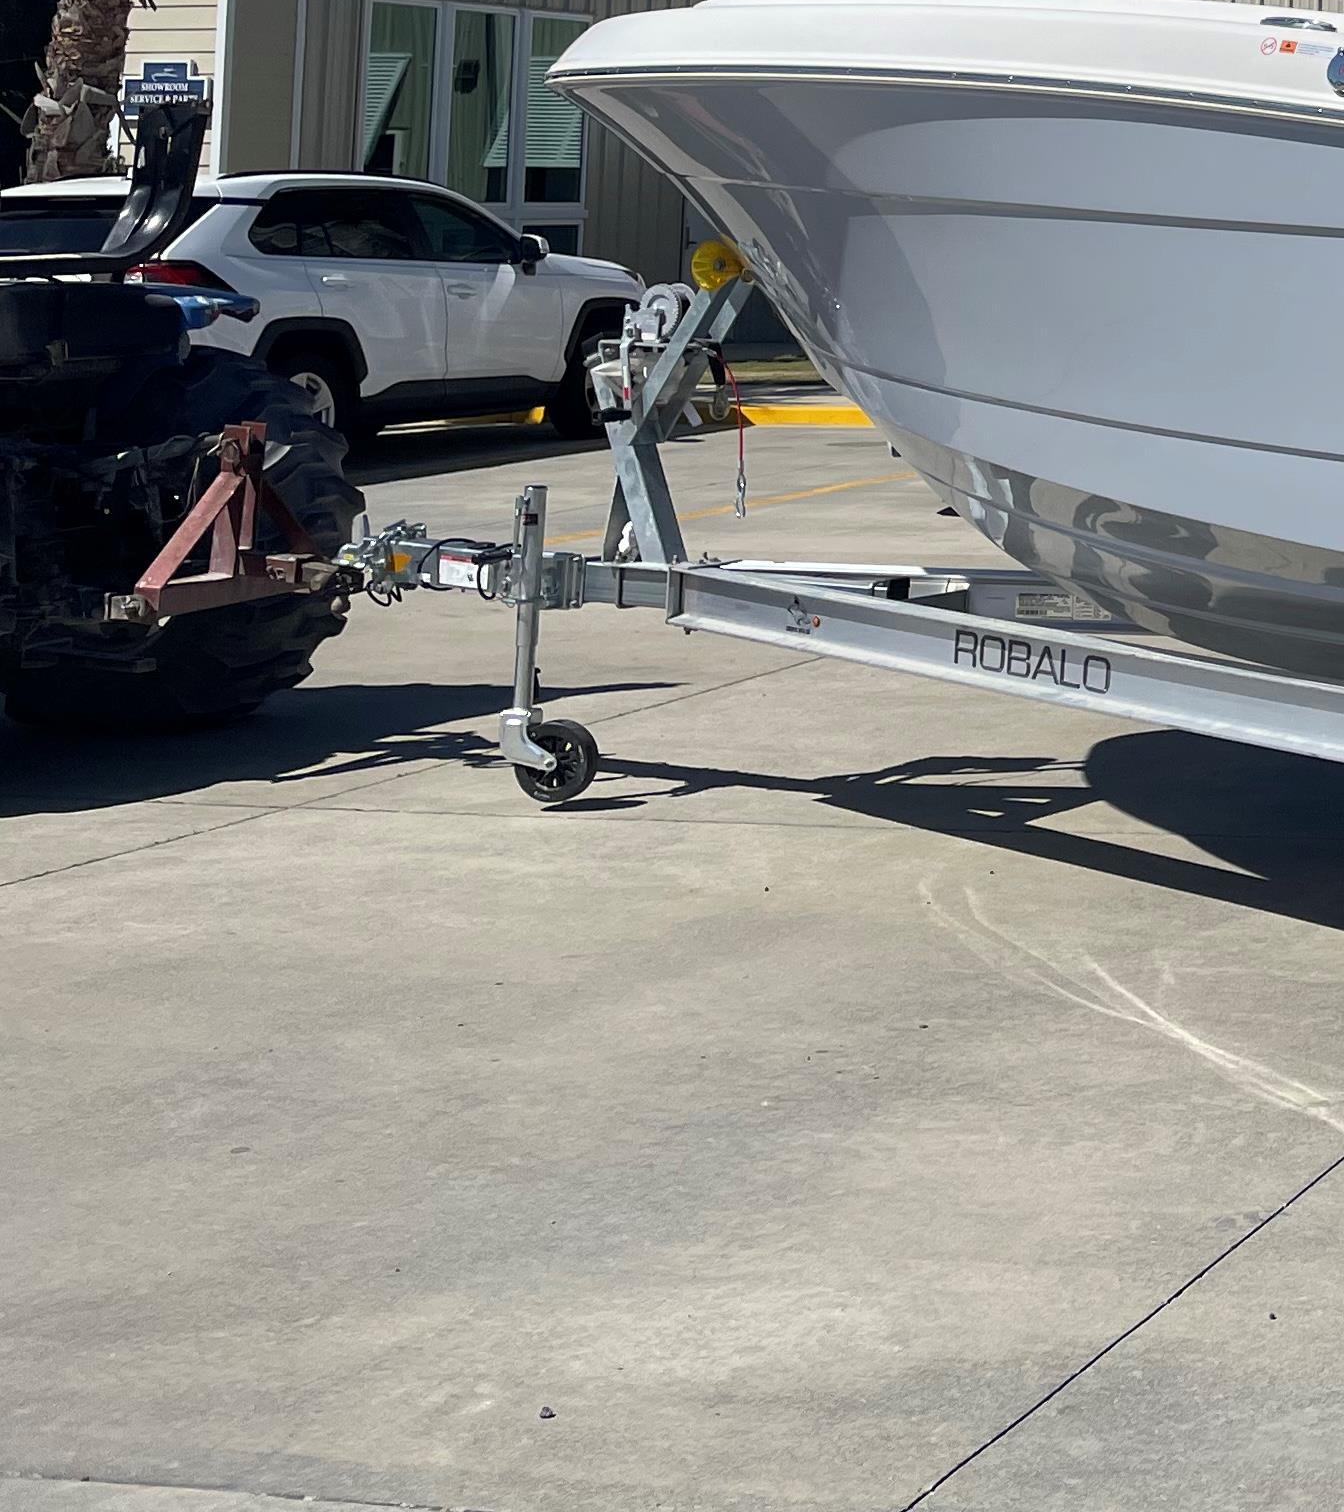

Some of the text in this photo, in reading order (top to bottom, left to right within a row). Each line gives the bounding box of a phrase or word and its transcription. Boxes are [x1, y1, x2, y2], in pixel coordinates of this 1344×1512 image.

[141, 82, 189, 92] SHOWROOM
[129, 94, 164, 104] SERVICE
[953, 629, 1111, 695] ROBALO
